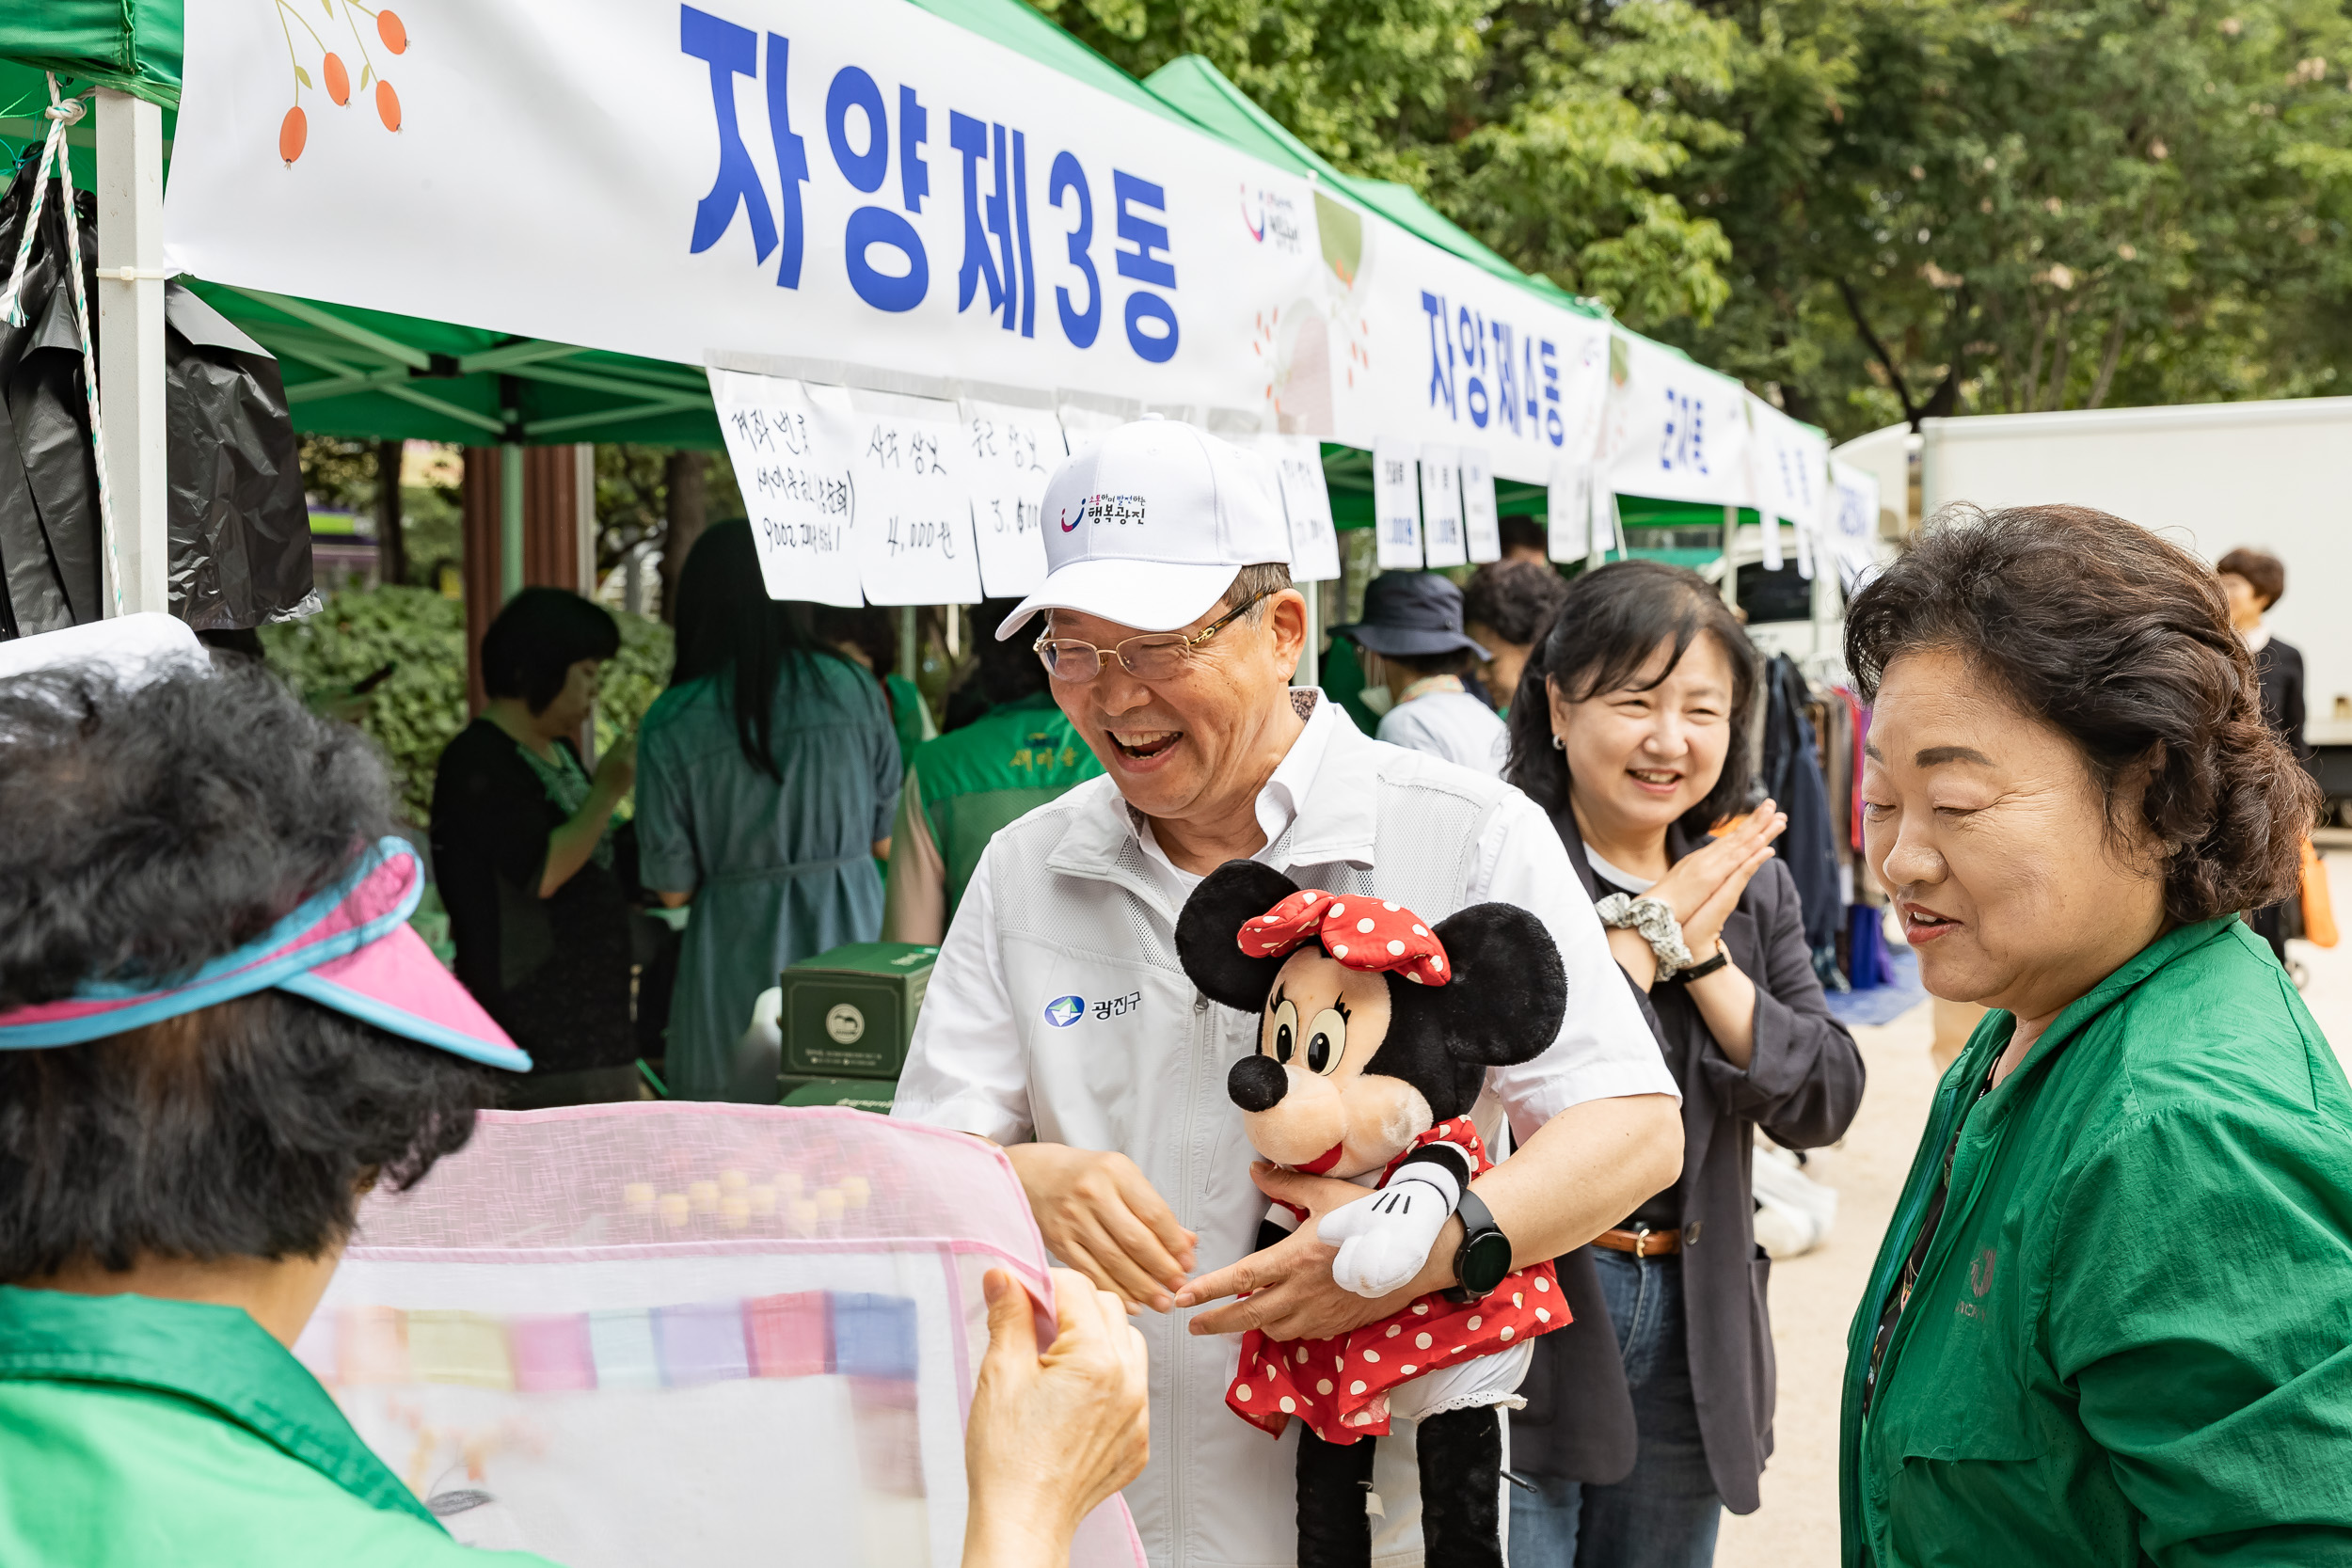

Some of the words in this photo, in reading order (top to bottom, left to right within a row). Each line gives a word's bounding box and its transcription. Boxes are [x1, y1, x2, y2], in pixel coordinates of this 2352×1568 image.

[681, 3, 1179, 364] 자양제3동
[1422, 290, 1564, 447] 자양제4동
[1088, 504, 1146, 525] 행복광진
[1091, 990, 1142, 1021] 광진구
